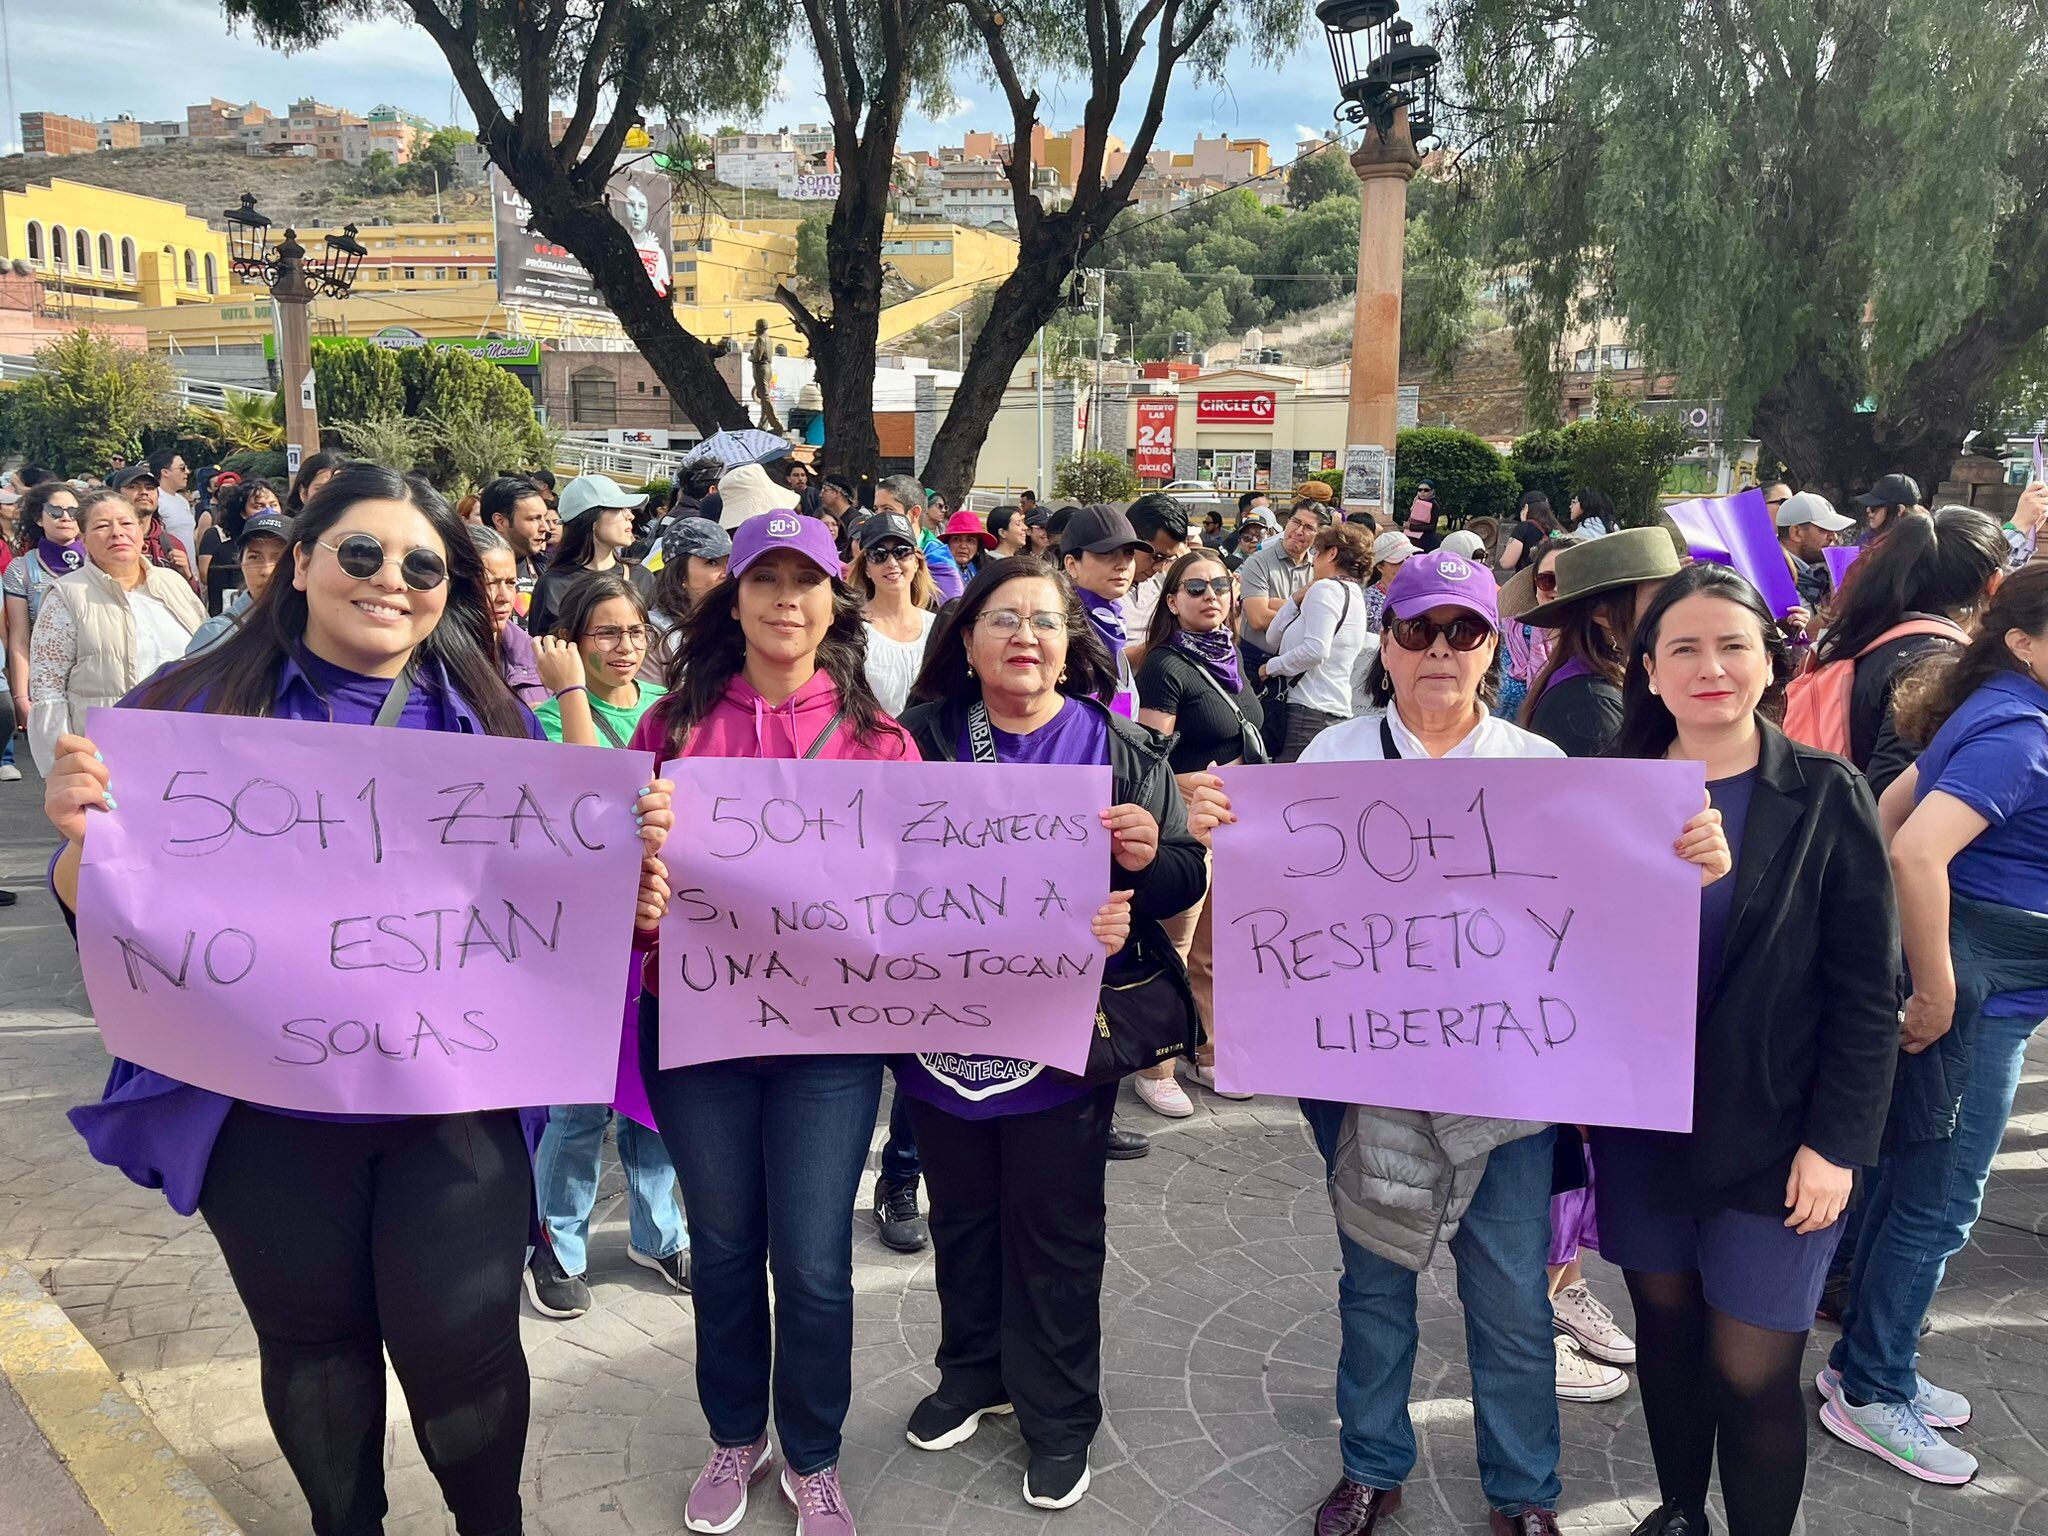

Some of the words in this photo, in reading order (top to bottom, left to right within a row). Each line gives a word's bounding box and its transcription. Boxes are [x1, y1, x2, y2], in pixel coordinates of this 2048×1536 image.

[221, 306, 251, 320] HOTEL
[486, 340, 534, 358] Manda!
[1200, 399, 1250, 412] CIRCLE
[1251, 395, 1272, 416] K
[622, 431, 652, 442] FedEx
[1138, 425, 1173, 447] 24
[1138, 446, 1172, 455] HORAS
[1137, 463, 1161, 471] CIRCLE
[1161, 462, 1171, 474] K
[769, 519, 796, 533] 50+1
[1440, 560, 1467, 576] 50+1
[161, 769, 383, 864] 50+1
[427, 780, 606, 858] ZAC
[709, 788, 866, 860] 50+1
[1281, 786, 1558, 884] 50+1
[770, 900, 849, 936] NOS
[854, 876, 1008, 936] TOCAN
[1033, 877, 1073, 918] A
[113, 926, 257, 993] NO
[329, 898, 564, 974] ESTAN
[1230, 906, 1506, 989] RESPETO
[1525, 906, 1575, 973] Y
[833, 951, 943, 986] NOS
[947, 947, 1095, 979] TOCAN
[747, 994, 793, 1031] A
[813, 1001, 994, 1030] TODAS
[1315, 994, 1578, 1058] LIBERTAD
[269, 1009, 500, 1068] SOLAS
[925, 1053, 1031, 1081] ZACATECAS
